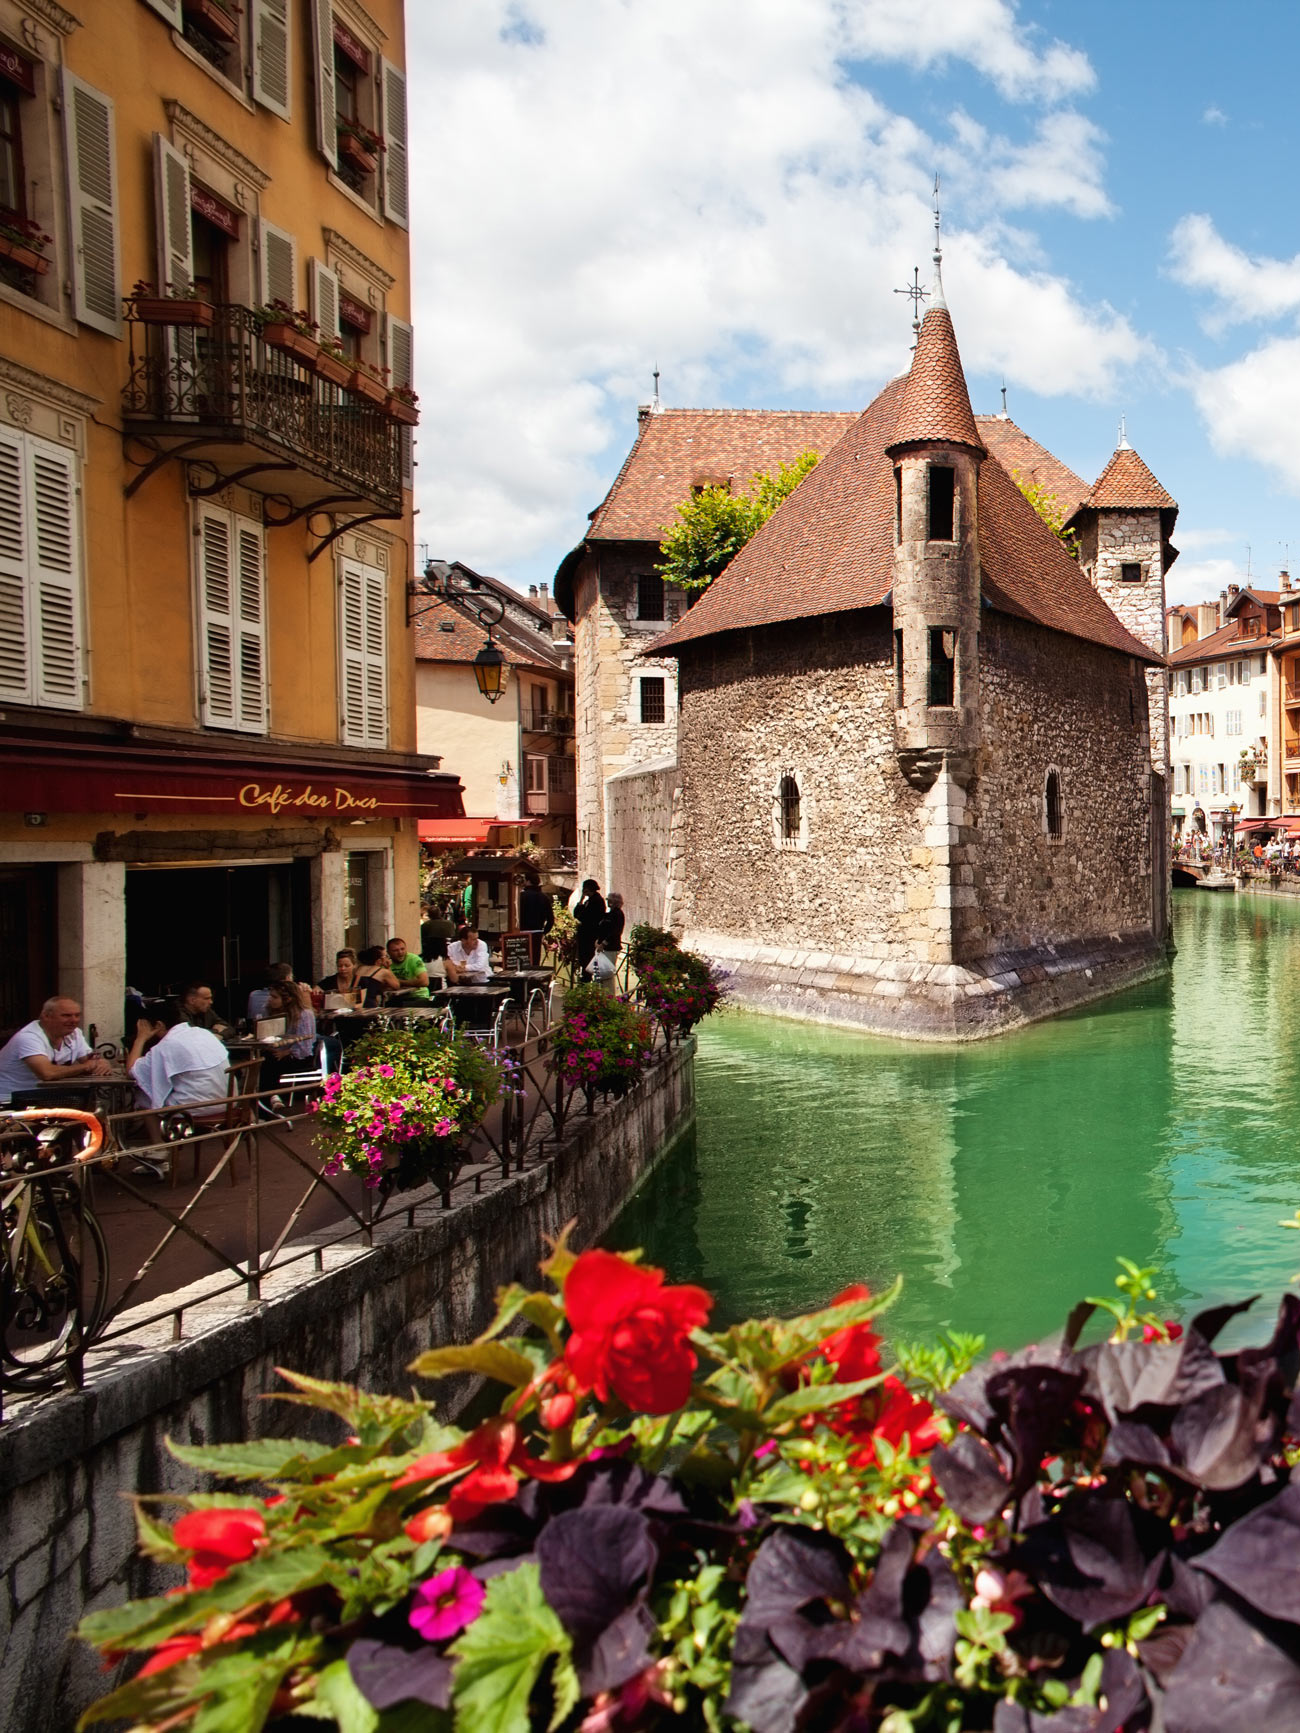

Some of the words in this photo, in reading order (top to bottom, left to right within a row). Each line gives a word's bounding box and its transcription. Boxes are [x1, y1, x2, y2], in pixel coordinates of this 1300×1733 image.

[239, 784, 293, 814] Café
[293, 785, 331, 808] des
[335, 787, 379, 810] Ducs
